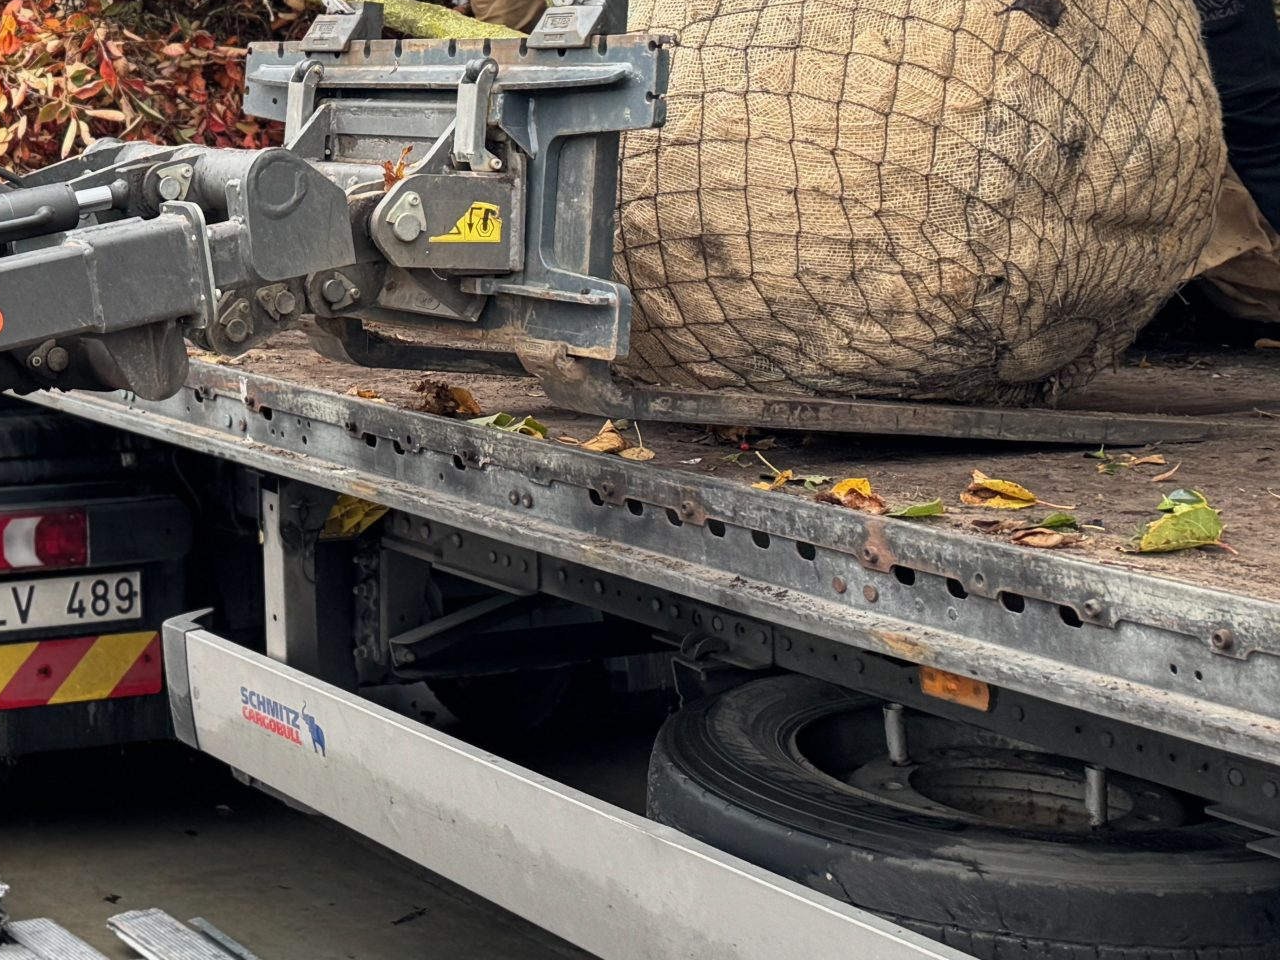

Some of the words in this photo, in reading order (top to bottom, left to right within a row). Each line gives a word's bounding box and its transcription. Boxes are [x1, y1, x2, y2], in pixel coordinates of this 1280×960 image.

[66, 577, 134, 619] 489
[240, 686, 301, 729] SCHMITZ
[242, 706, 303, 746] CARGOBULL
